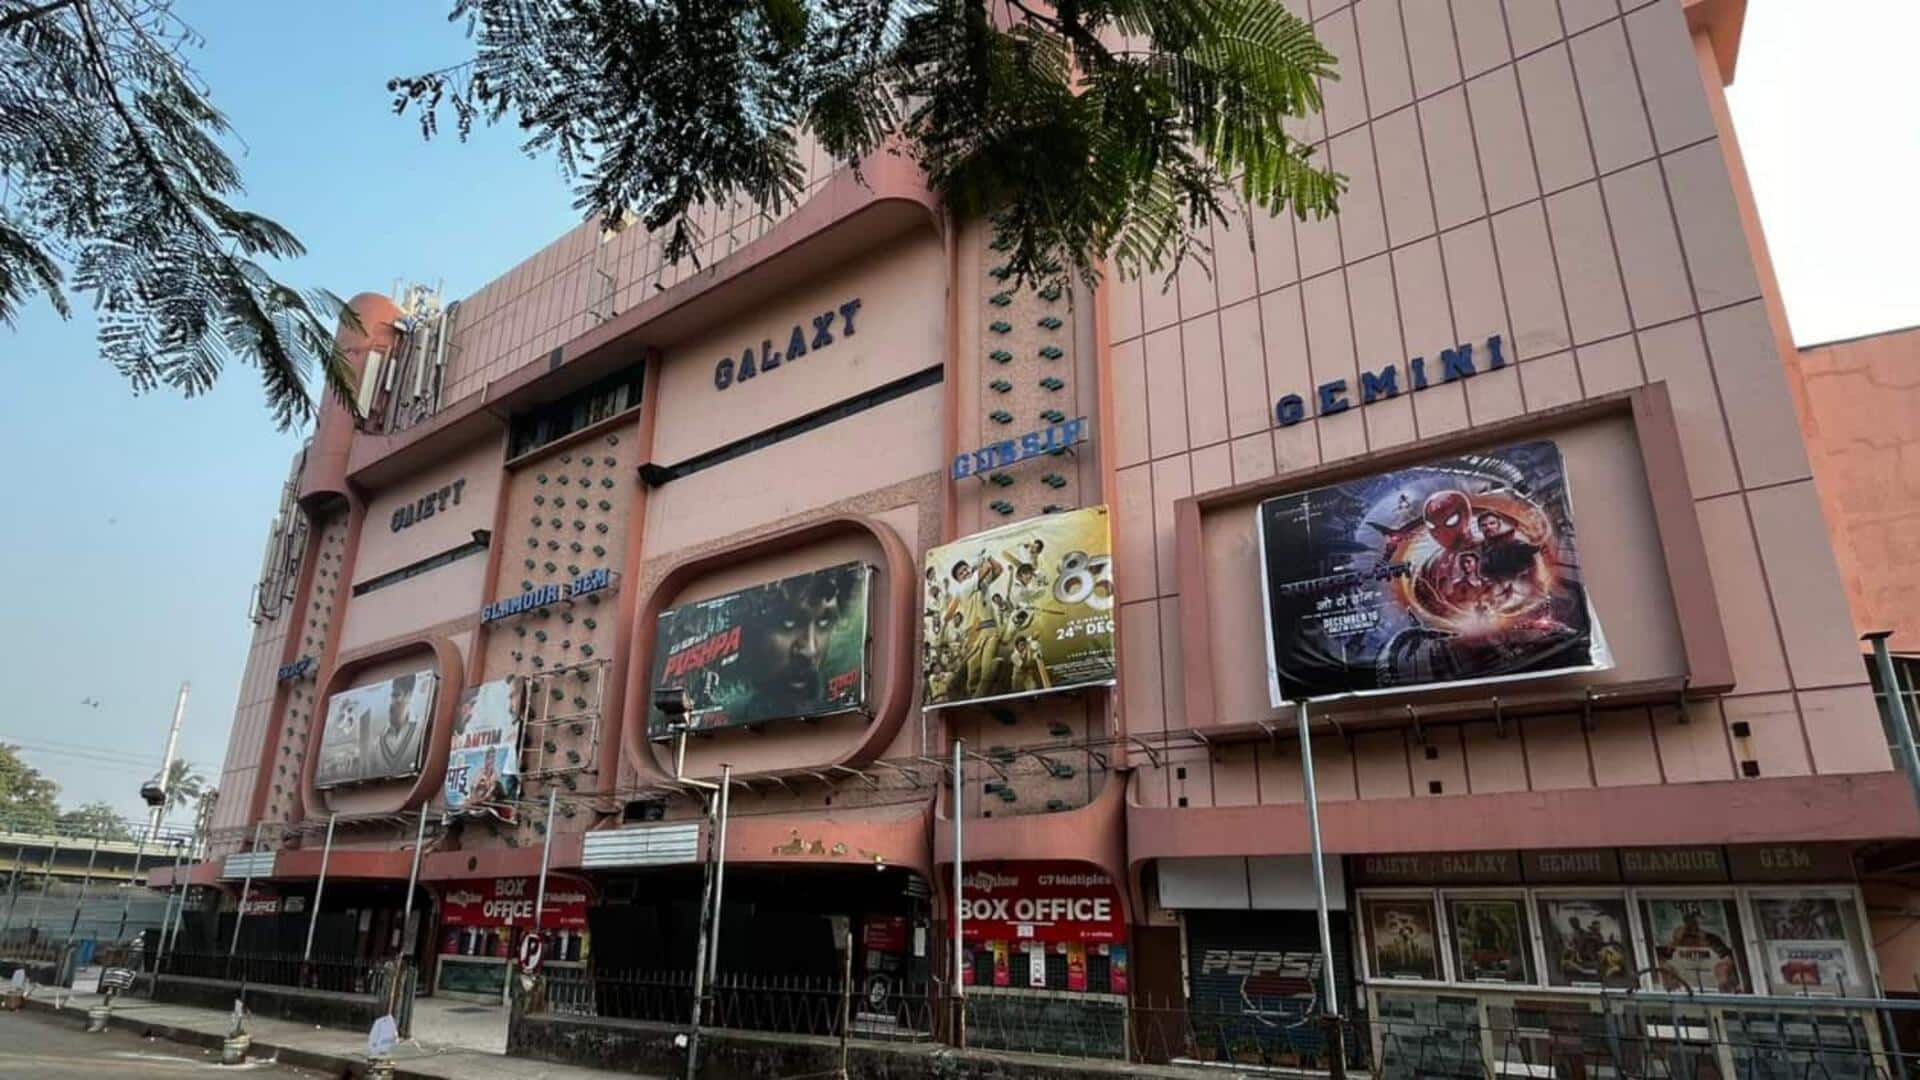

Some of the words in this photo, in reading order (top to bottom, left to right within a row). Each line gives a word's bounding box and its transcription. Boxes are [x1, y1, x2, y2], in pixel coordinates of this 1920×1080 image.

[714, 298, 862, 391] GALAXY
[1276, 335, 1506, 426] GEMINI
[390, 478, 466, 533] GAIETY
[481, 584, 561, 624] GLAMOUR
[572, 568, 611, 598] GEM
[660, 626, 743, 685] PUSHPA
[495, 878, 528, 896] BOX
[1365, 856, 1419, 876] GAIETY
[1441, 854, 1507, 874] GALAXY
[1538, 853, 1601, 873] GEMINI
[1625, 850, 1720, 872] GLAMOUR
[1759, 848, 1811, 868] GEM
[961, 898, 1009, 921] BOX
[1014, 897, 1112, 921] OFFICE
[1201, 949, 1323, 979] PEPSI
